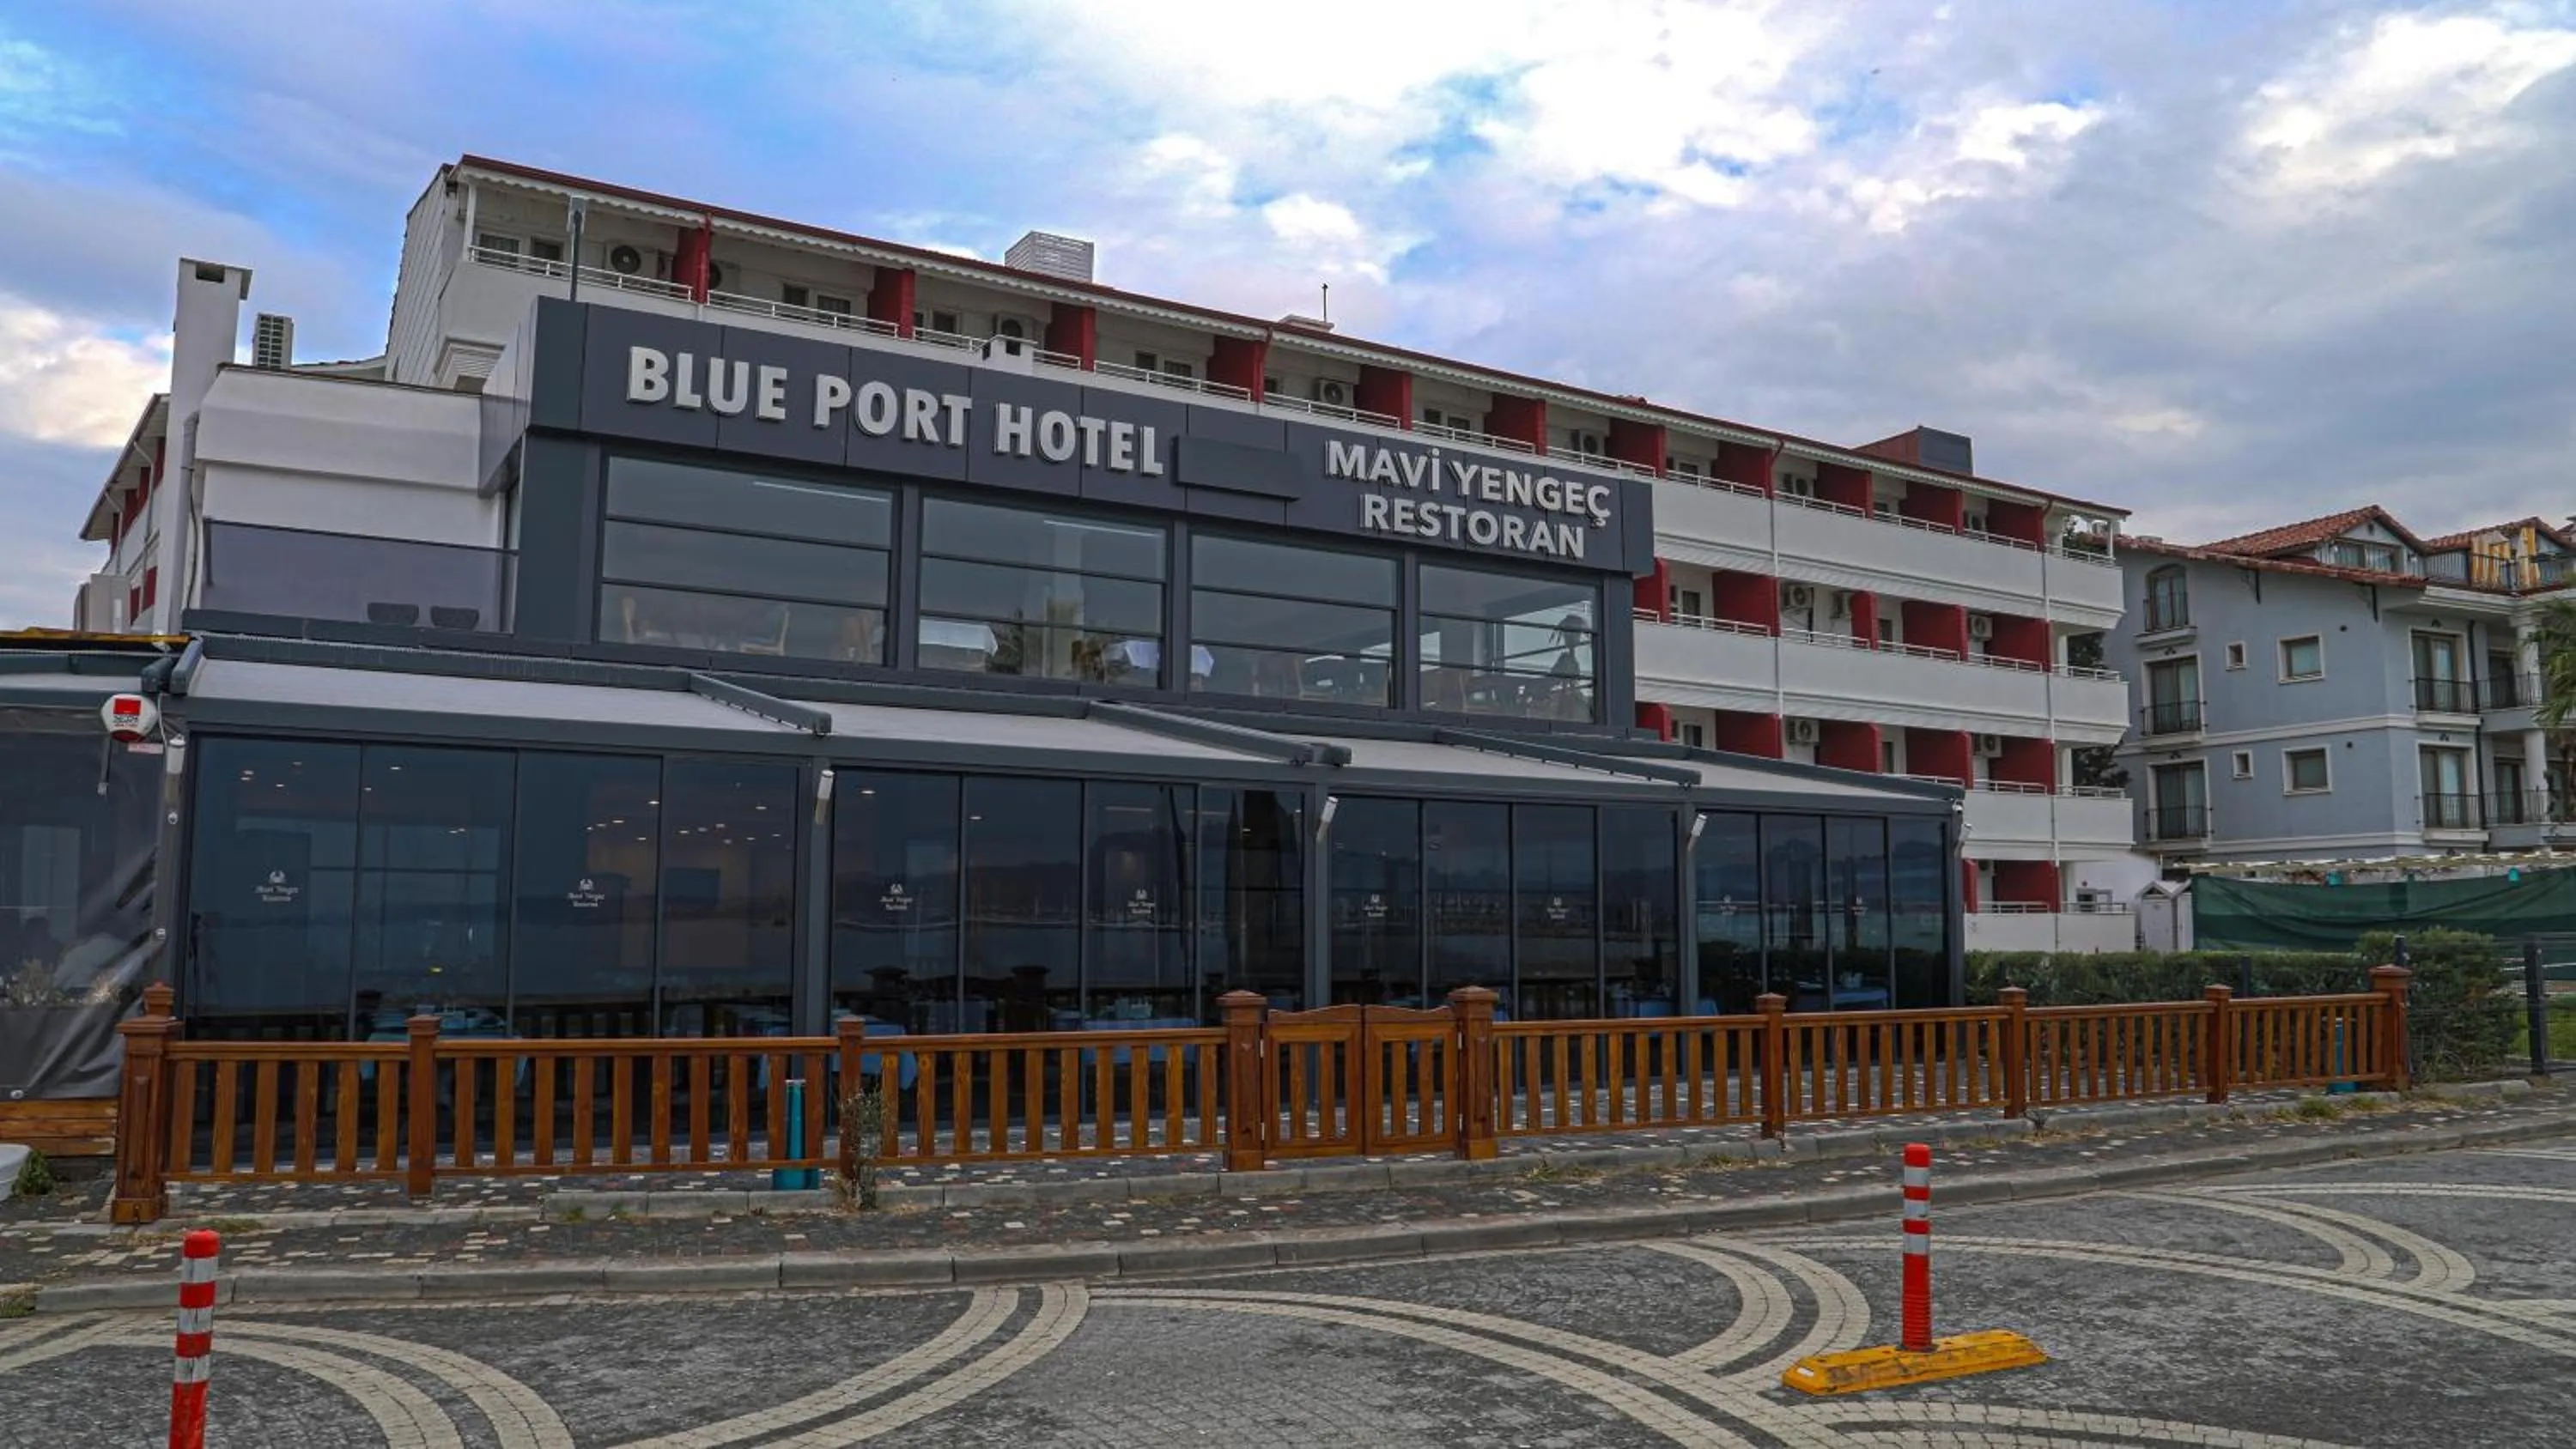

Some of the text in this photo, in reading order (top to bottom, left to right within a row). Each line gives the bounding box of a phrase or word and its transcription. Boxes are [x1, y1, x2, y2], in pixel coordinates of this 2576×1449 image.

[627, 347, 1164, 476] BLUE PORT HOTEL
[1325, 440, 1612, 527] MAVİ YENGEÇ
[1360, 494, 1585, 559] RESTORAN
